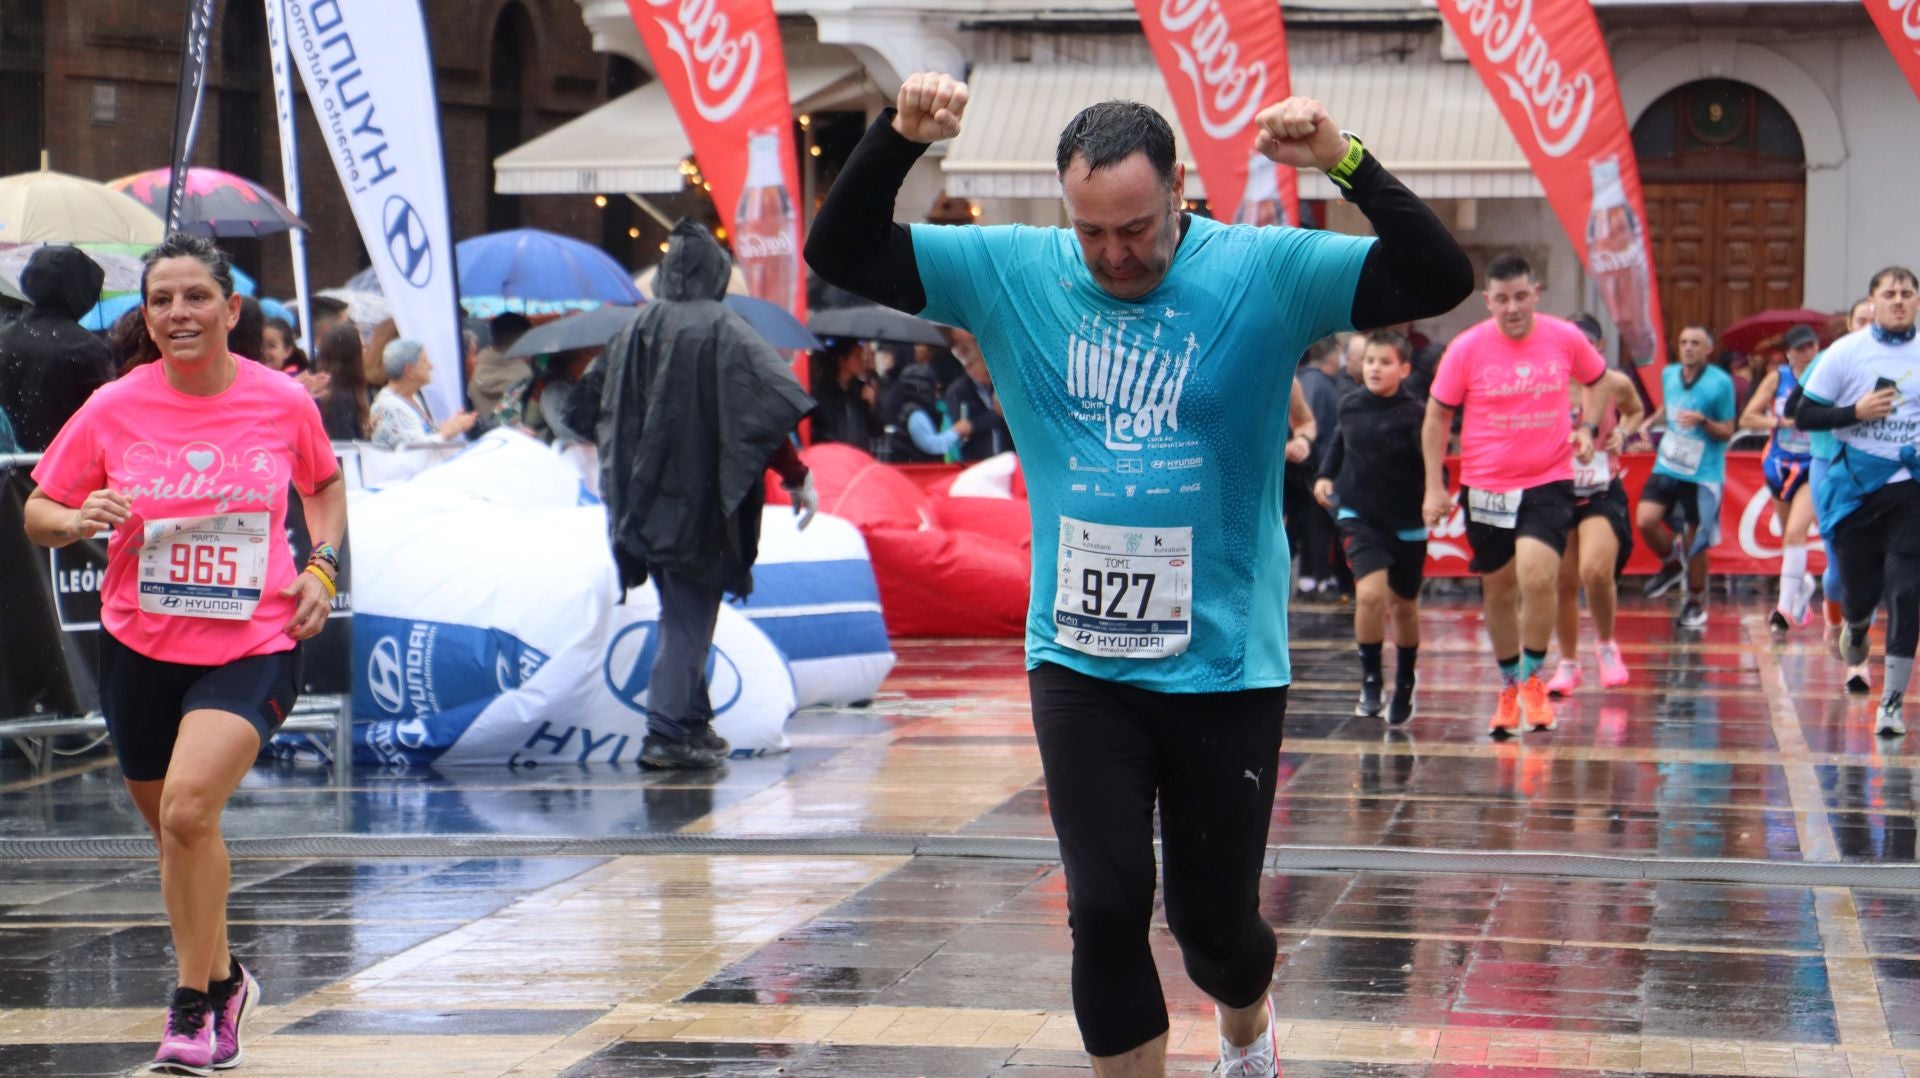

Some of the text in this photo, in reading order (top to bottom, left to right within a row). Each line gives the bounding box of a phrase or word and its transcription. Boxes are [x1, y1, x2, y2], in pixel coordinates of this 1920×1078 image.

[1709, 103, 1723, 122] 9
[1081, 400, 1104, 409] 10km
[1167, 457, 1203, 467] HYUNDAI
[120, 472, 277, 513] intelligent
[191, 534, 220, 543] MARTA
[169, 543, 238, 586] 965
[1105, 557, 1132, 569] TOMI
[1082, 568, 1156, 619] 927
[185, 599, 243, 611] HYUNDAI
[1097, 635, 1165, 648] HYUNDAI
[405, 622, 429, 719] YUNDAI
